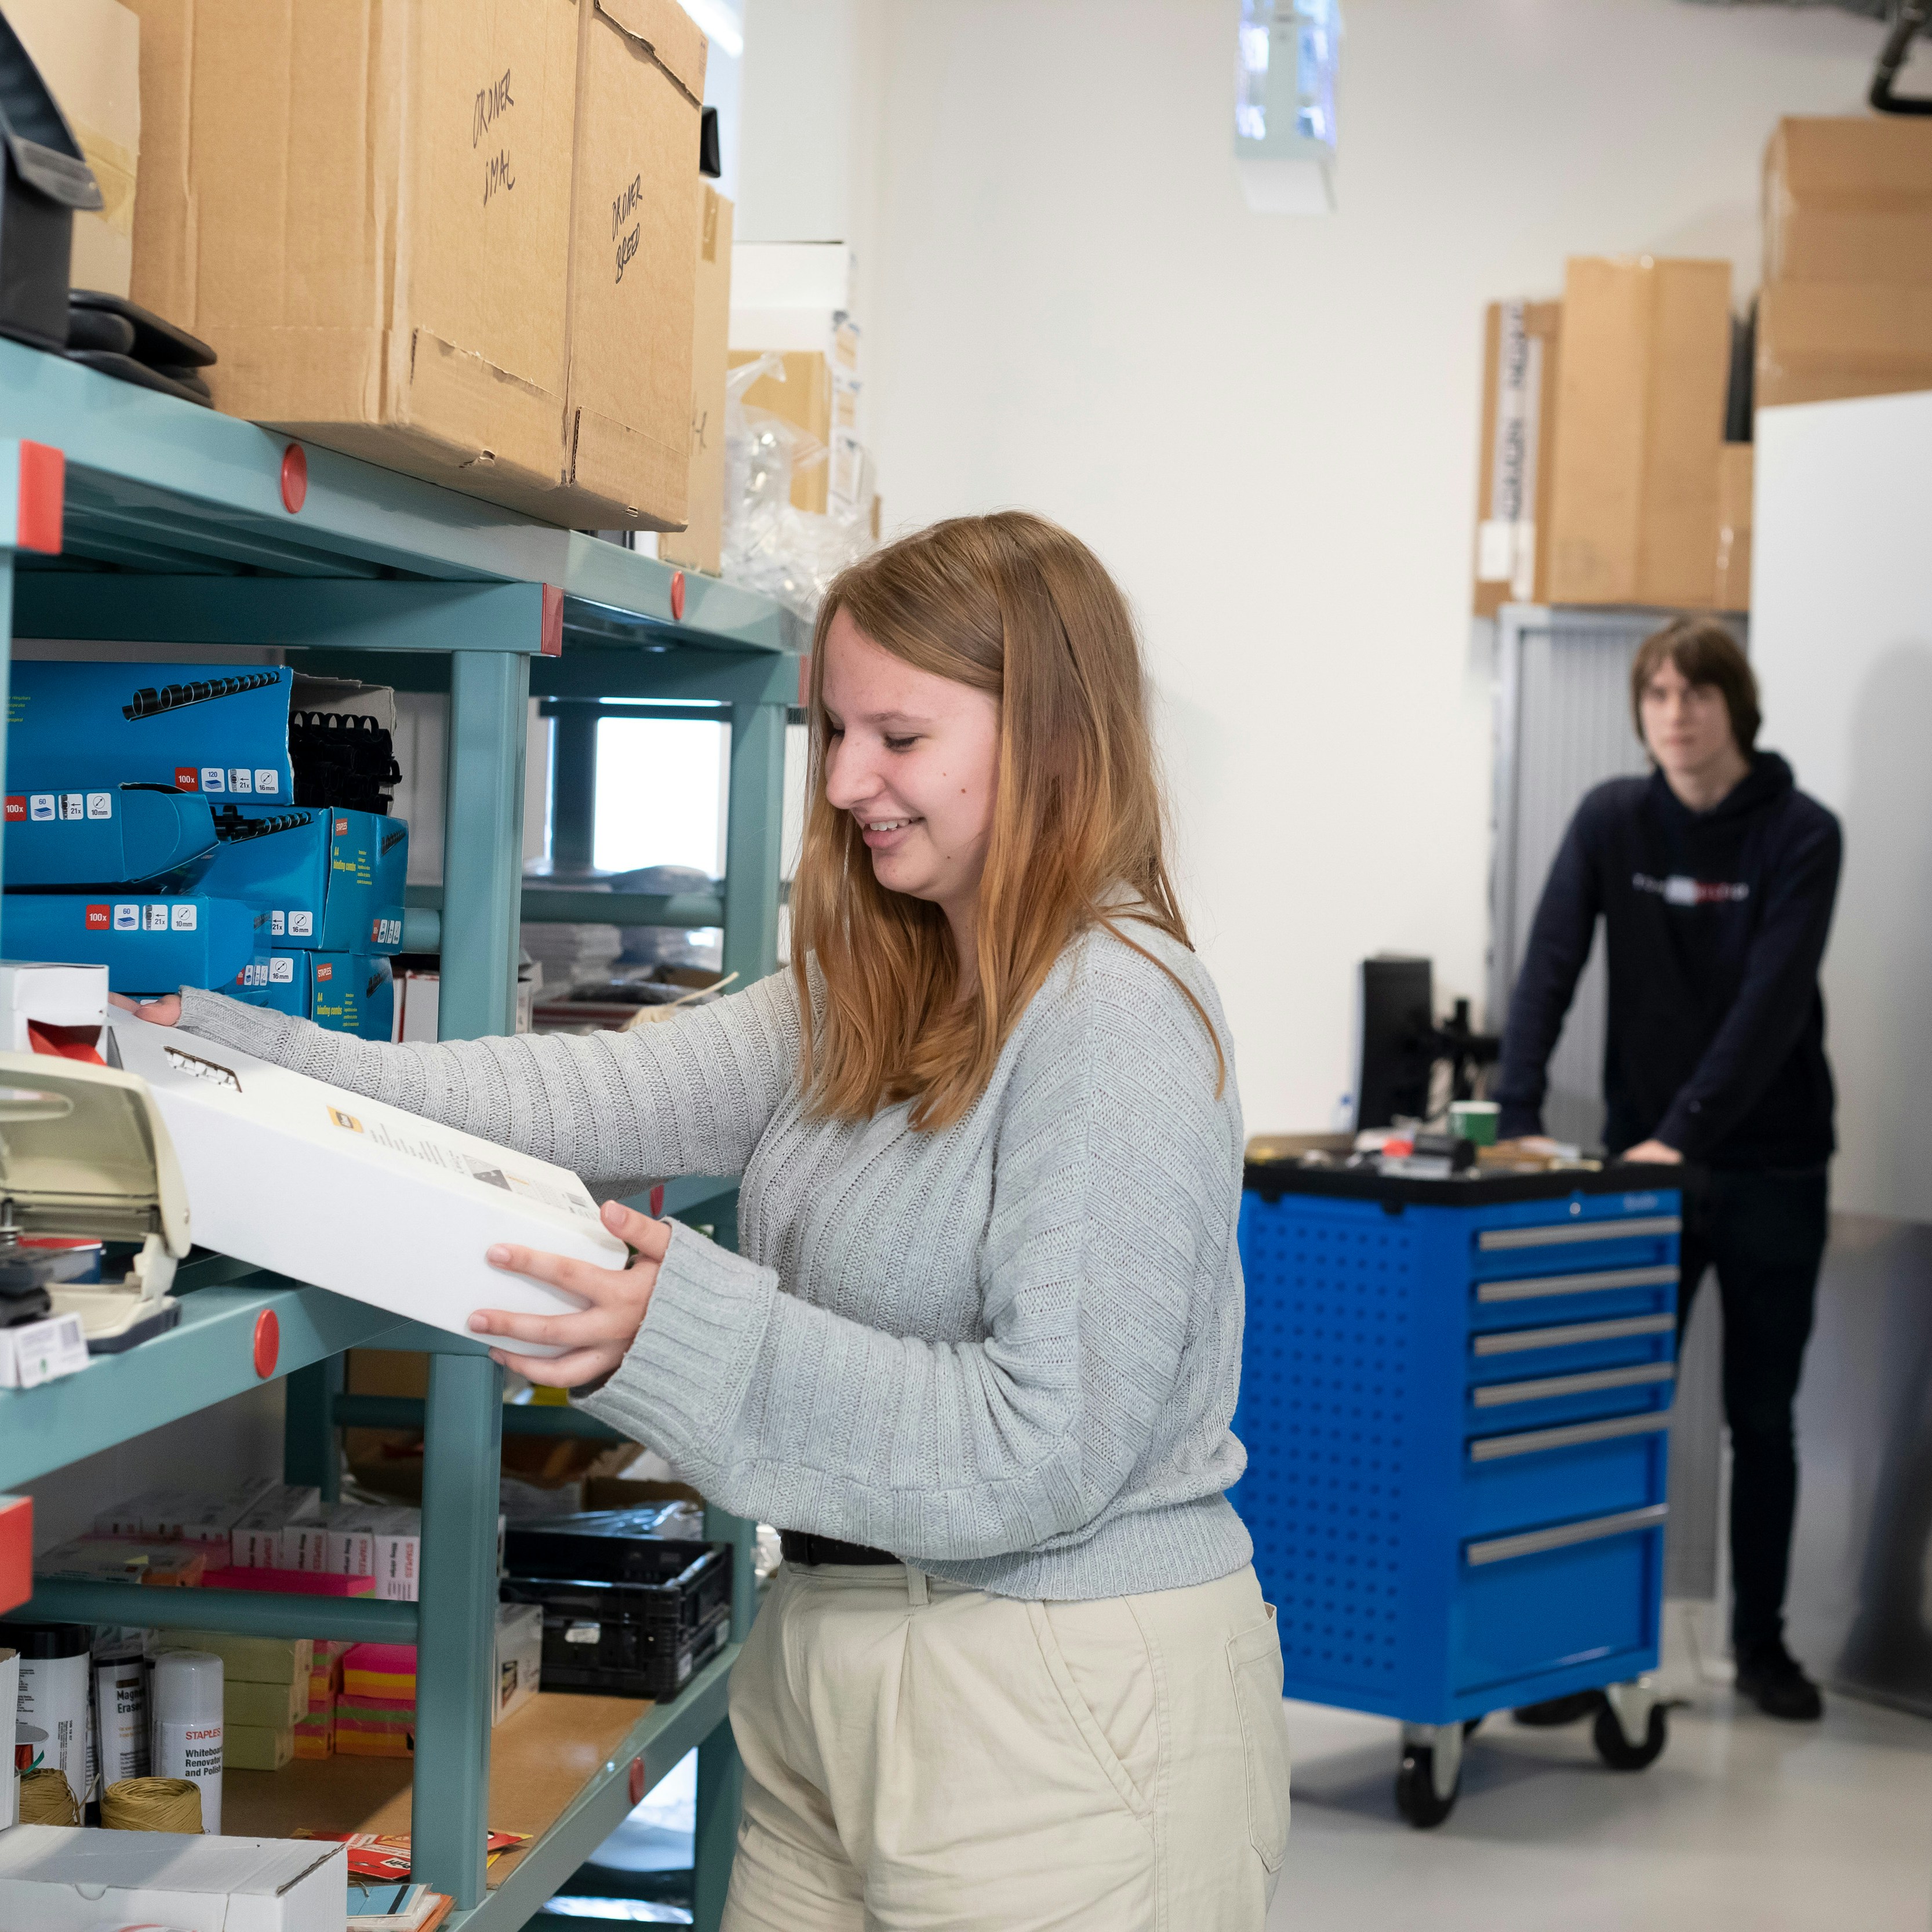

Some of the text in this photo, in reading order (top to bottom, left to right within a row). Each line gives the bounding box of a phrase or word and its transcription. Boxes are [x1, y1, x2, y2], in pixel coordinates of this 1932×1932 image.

[473, 68, 514, 149] ORDNER
[616, 222, 641, 284] BREED
[179, 775, 195, 783] 100x
[6, 805, 24, 813] 100x
[336, 821, 347, 831] STAPLES
[334, 846, 339, 856] A4
[333, 859, 356, 872] binding combs
[89, 913, 107, 921] 100x
[318, 967, 332, 977] STAPLES
[317, 992, 323, 1002] A4
[317, 1005, 342, 1017] binding combs
[406, 1542, 414, 1578] STAPLES
[185, 1727, 221, 1740] STAPLES
[185, 1744, 223, 1758] Whiteboar
[185, 1756, 221, 1767] Renovator
[185, 1769, 201, 1777] and
